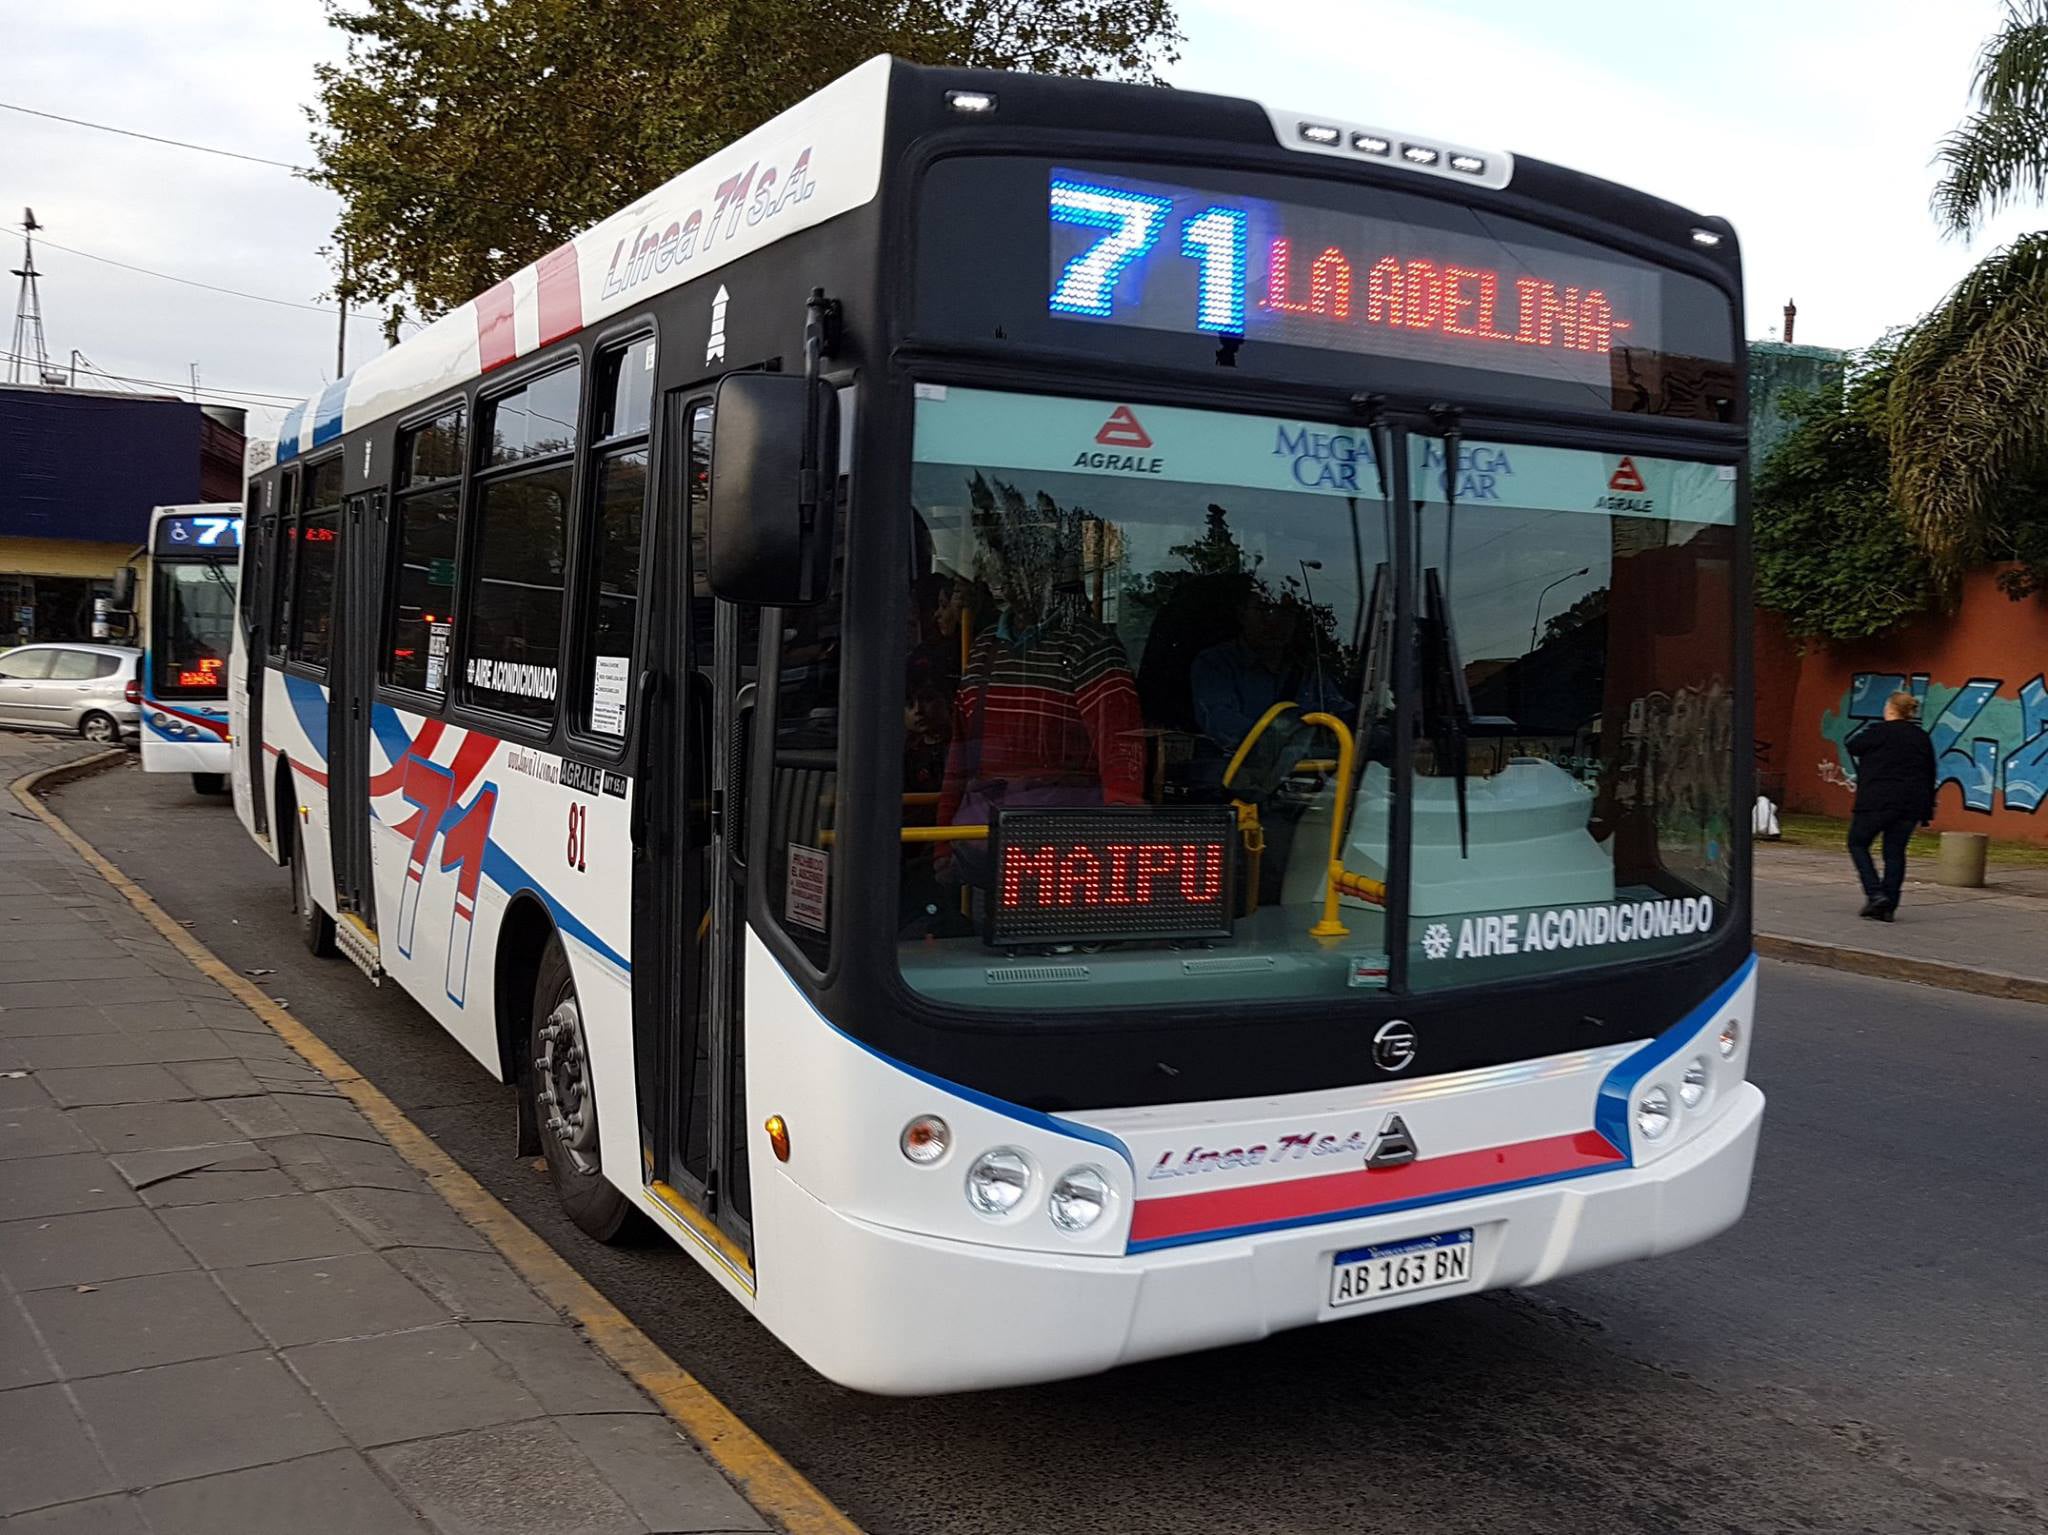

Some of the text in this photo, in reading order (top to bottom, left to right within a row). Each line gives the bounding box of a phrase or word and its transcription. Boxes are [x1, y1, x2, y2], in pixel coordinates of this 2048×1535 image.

[702, 160, 760, 252] 71
[1050, 177, 1247, 333] 71
[1073, 452, 1164, 473] AGRALE
[1272, 424, 1376, 465] MEGA
[1293, 454, 1363, 491] CAR
[1594, 496, 1655, 512] AGRALE
[474, 658, 492, 689] AIRE
[491, 661, 557, 701] ACONDICIONADO
[560, 760, 601, 795] AGRALE
[567, 802, 587, 873] 81
[1004, 845, 1221, 906] MAIPU
[1455, 896, 1713, 959] AIRE ACONDICIONADO
[1270, 1132, 1317, 1163] 71
[1338, 1266, 1370, 1301] AB
[1379, 1255, 1427, 1290] 163
[1434, 1246, 1467, 1280] BN
